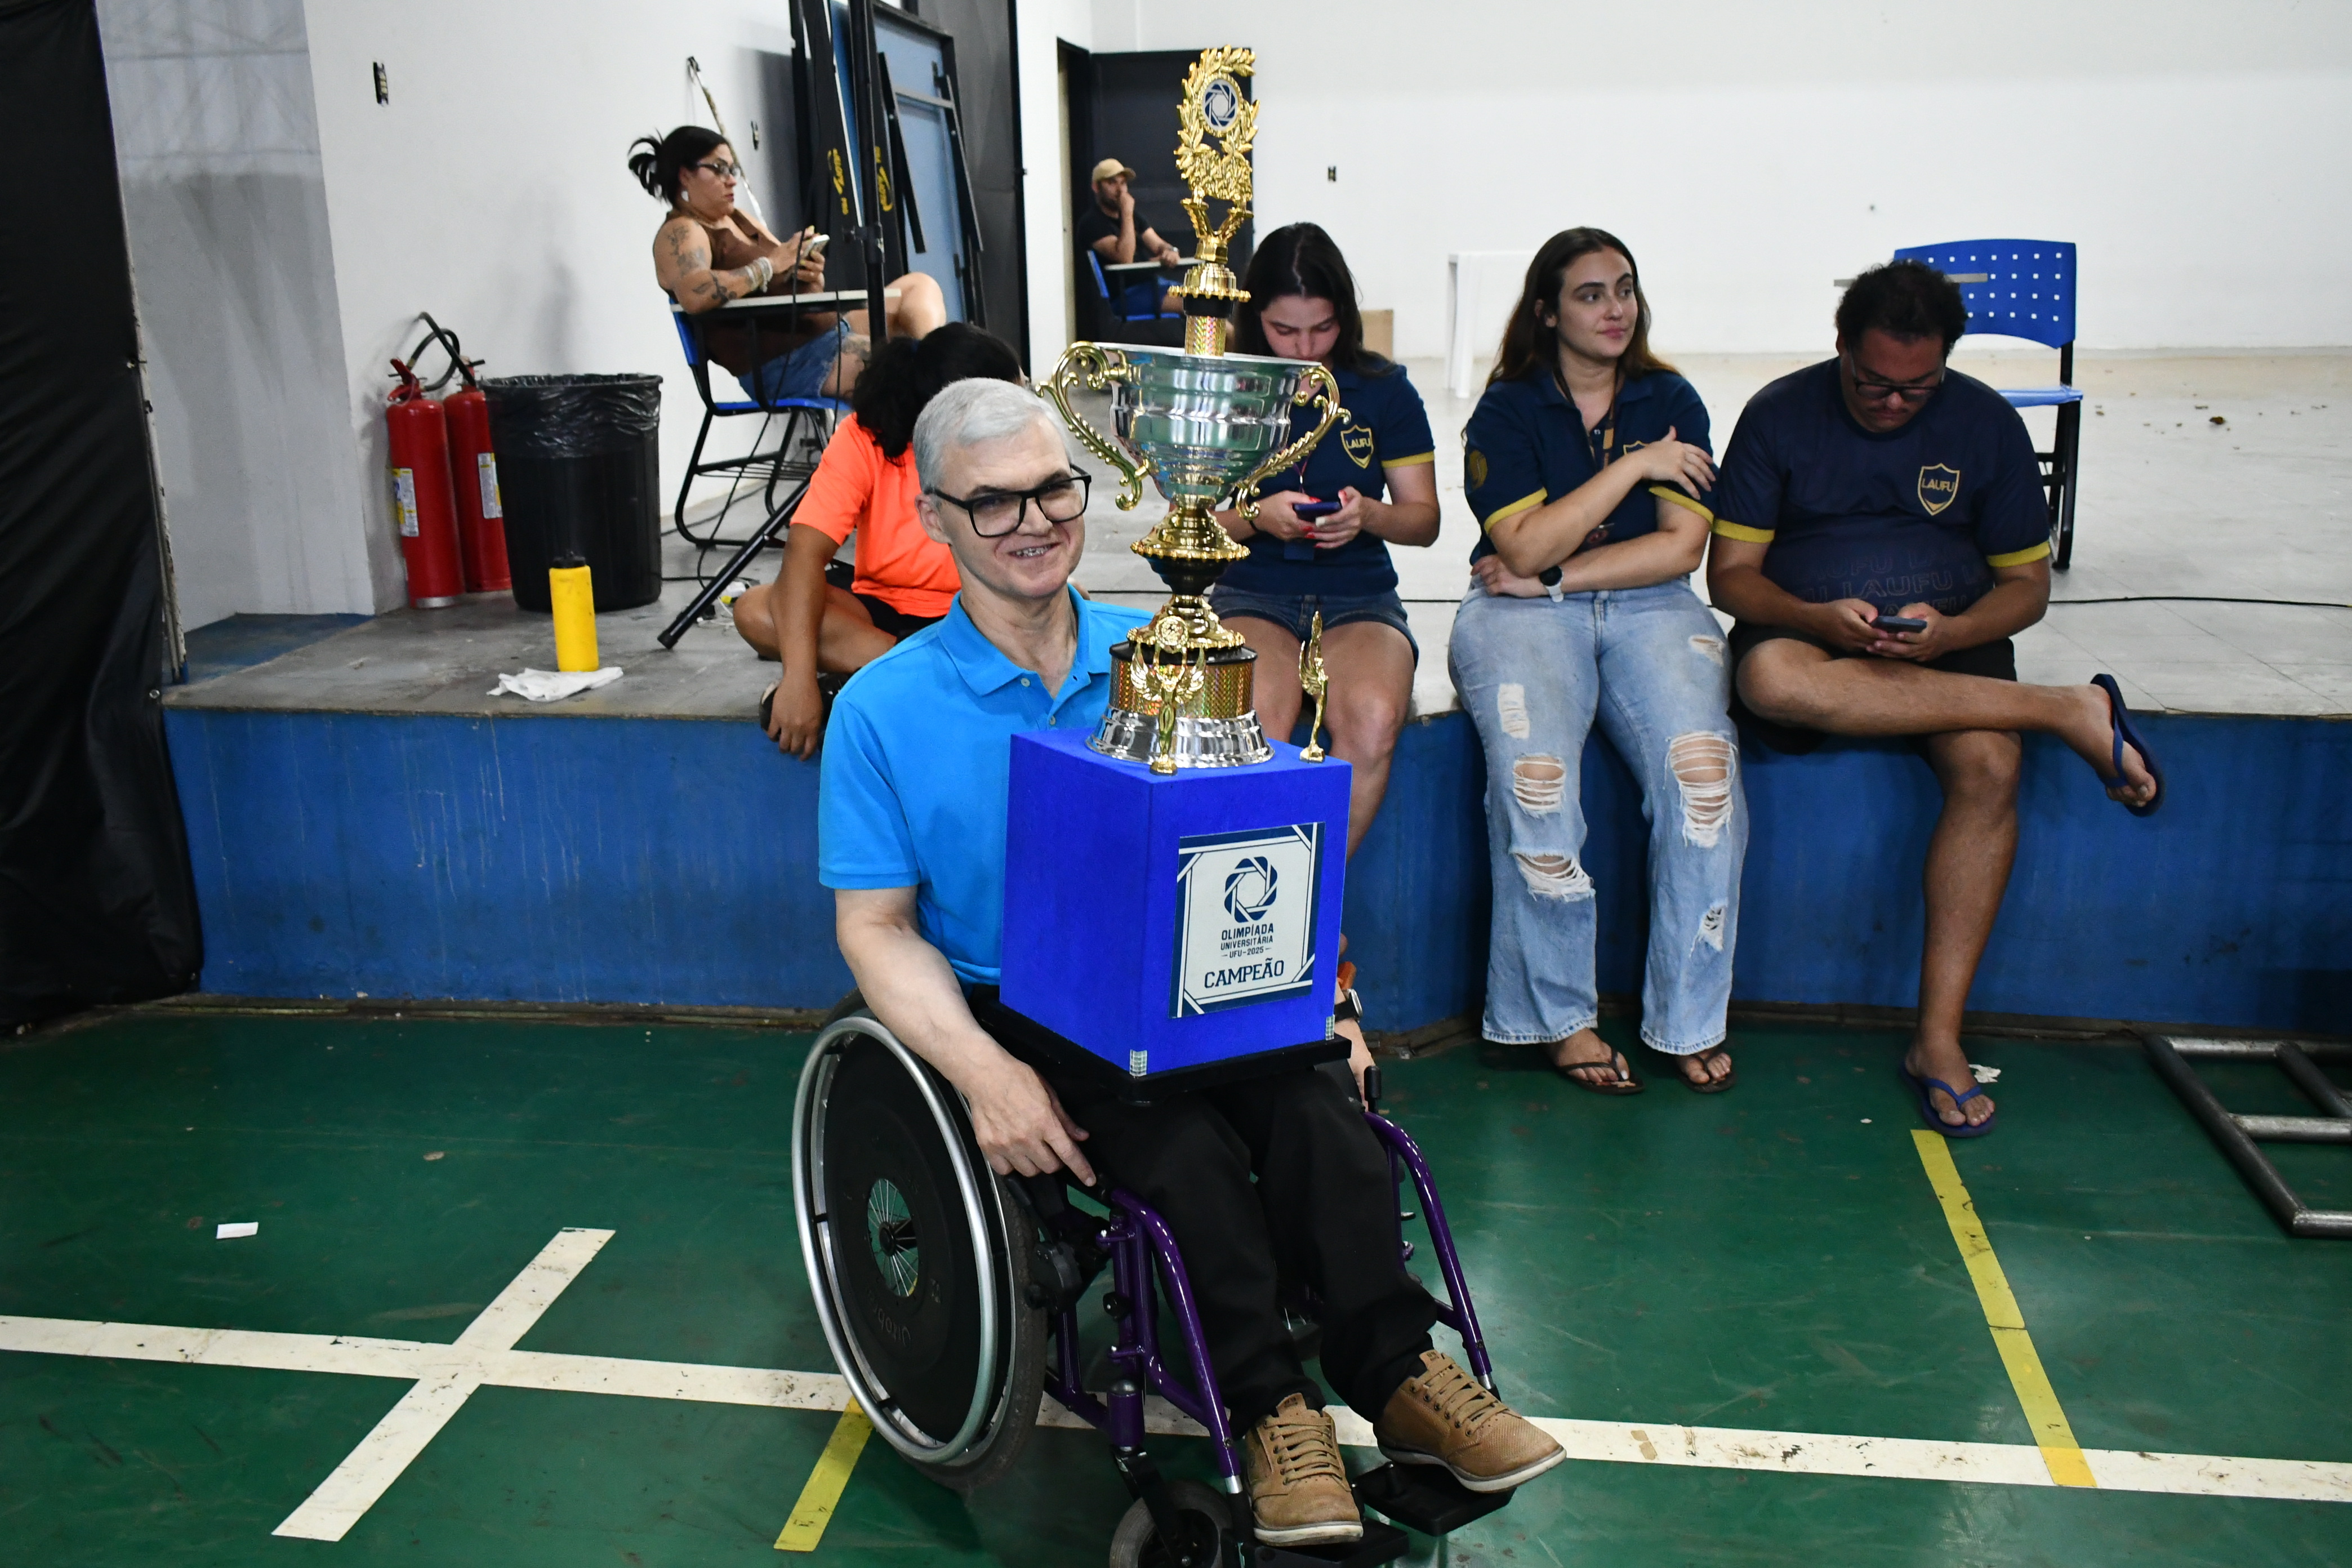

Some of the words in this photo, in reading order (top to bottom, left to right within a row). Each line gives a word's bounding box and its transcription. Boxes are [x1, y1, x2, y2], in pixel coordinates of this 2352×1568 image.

[1921, 478, 1955, 492] LAUFU
[1842, 569, 1953, 600] LAUFU
[1221, 923, 1274, 941] OLIMPÍADA
[1220, 934, 1273, 951] UNIVERSITÁRIA
[1204, 957, 1284, 989] CAMPEÃO
